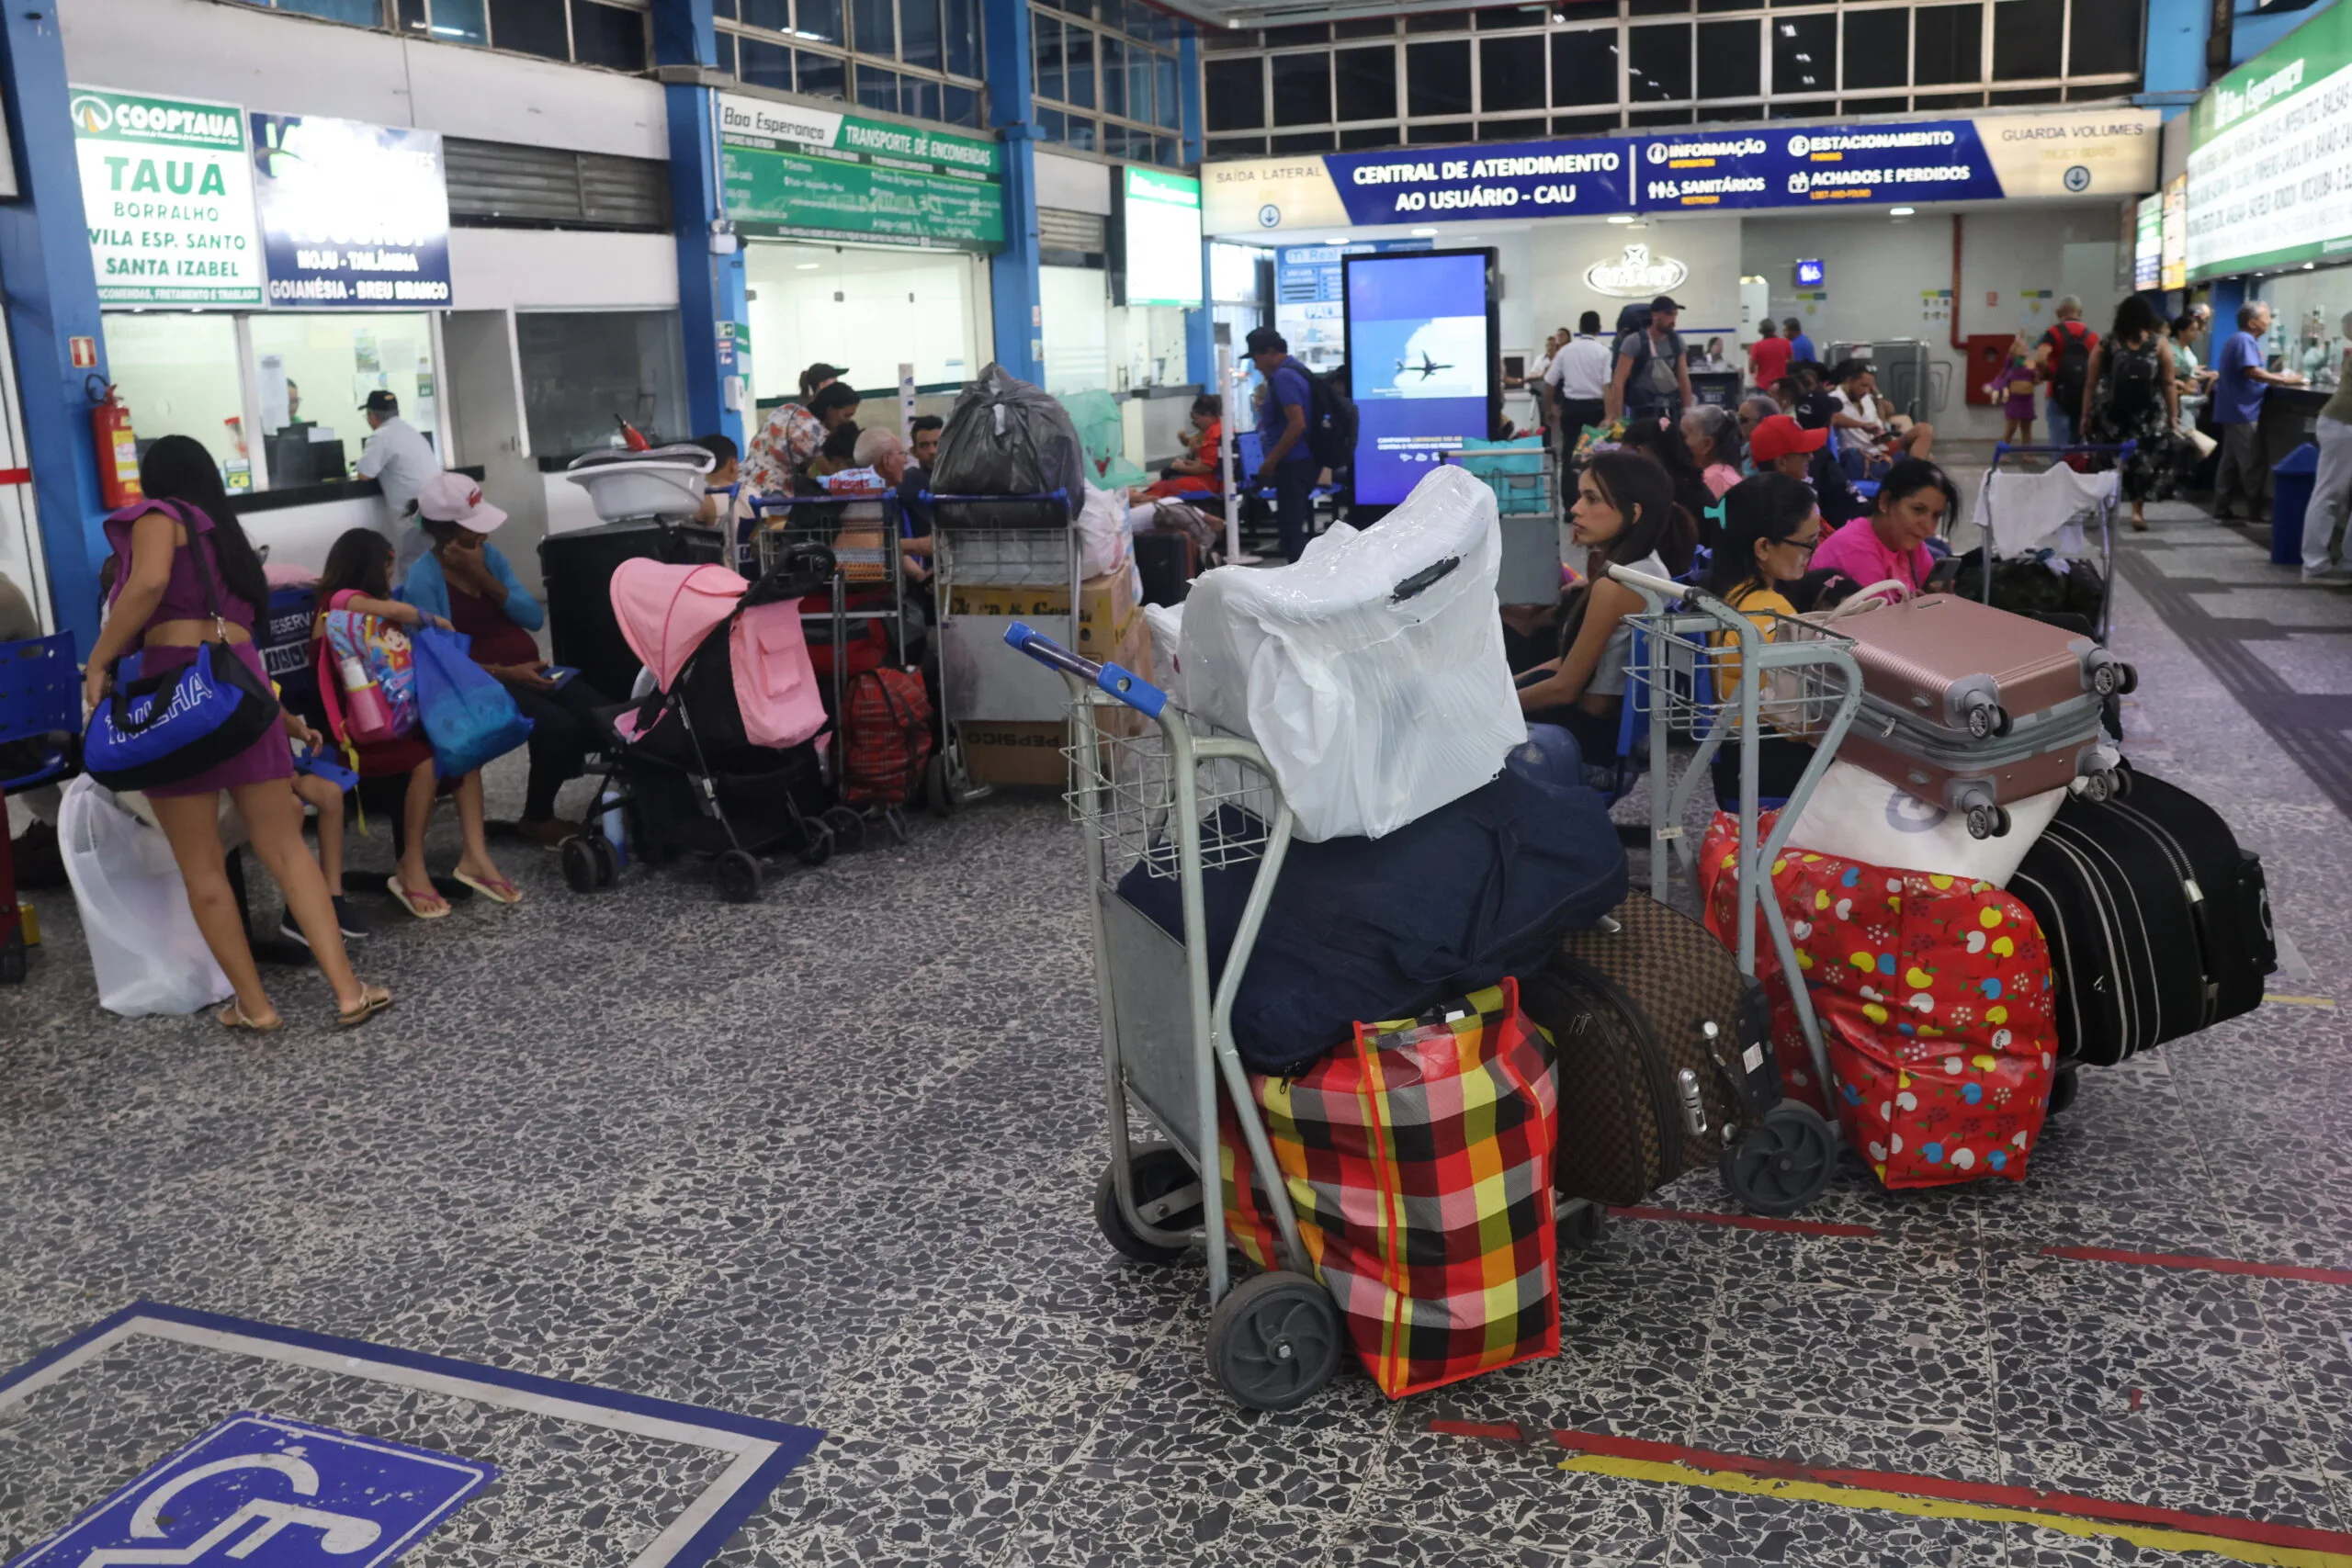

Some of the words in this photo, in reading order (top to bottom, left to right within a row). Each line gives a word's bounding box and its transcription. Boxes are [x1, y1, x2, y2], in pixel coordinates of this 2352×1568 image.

[115, 104, 239, 139] COOPTAUA
[2002, 127, 2066, 141] GUARDA
[2072, 123, 2144, 138] VOLUMES
[845, 125, 911, 153] TRANSPORTE
[915, 138, 929, 156] DE
[931, 141, 991, 166] ENCOMENDAS
[1668, 138, 1767, 158] INFORMAÇÃO
[1810, 130, 1955, 152] ESTACIONAMENTO
[1216, 169, 1256, 183] SAÍDA
[1262, 166, 1323, 181] LATERAL
[1353, 164, 1439, 185] CENTRAL
[1442, 161, 1469, 180] DE
[1472, 152, 1620, 178] ATENDIMENTO
[1810, 169, 1882, 186] ACHADOS
[1884, 169, 1894, 184] E
[1895, 165, 1971, 183] PERDIDOS
[1680, 175, 1766, 195] SANITÁRIOS
[1395, 192, 1426, 211] AO
[1430, 185, 1518, 209] USUÁRIO
[1533, 185, 1577, 204] CAU
[114, 201, 220, 222] BORRALHO
[89, 228, 133, 247] VILA
[141, 231, 178, 248] ESP.
[187, 233, 246, 251] SANTO
[107, 257, 170, 276] SANTA
[176, 259, 239, 277] IZABEL
[297, 250, 338, 270] MOJU
[270, 276, 347, 299] GOIANÉSIA
[356, 281, 394, 299] BREU
[395, 281, 449, 300] BRANCO
[968, 733, 1058, 748] PEPSICO
